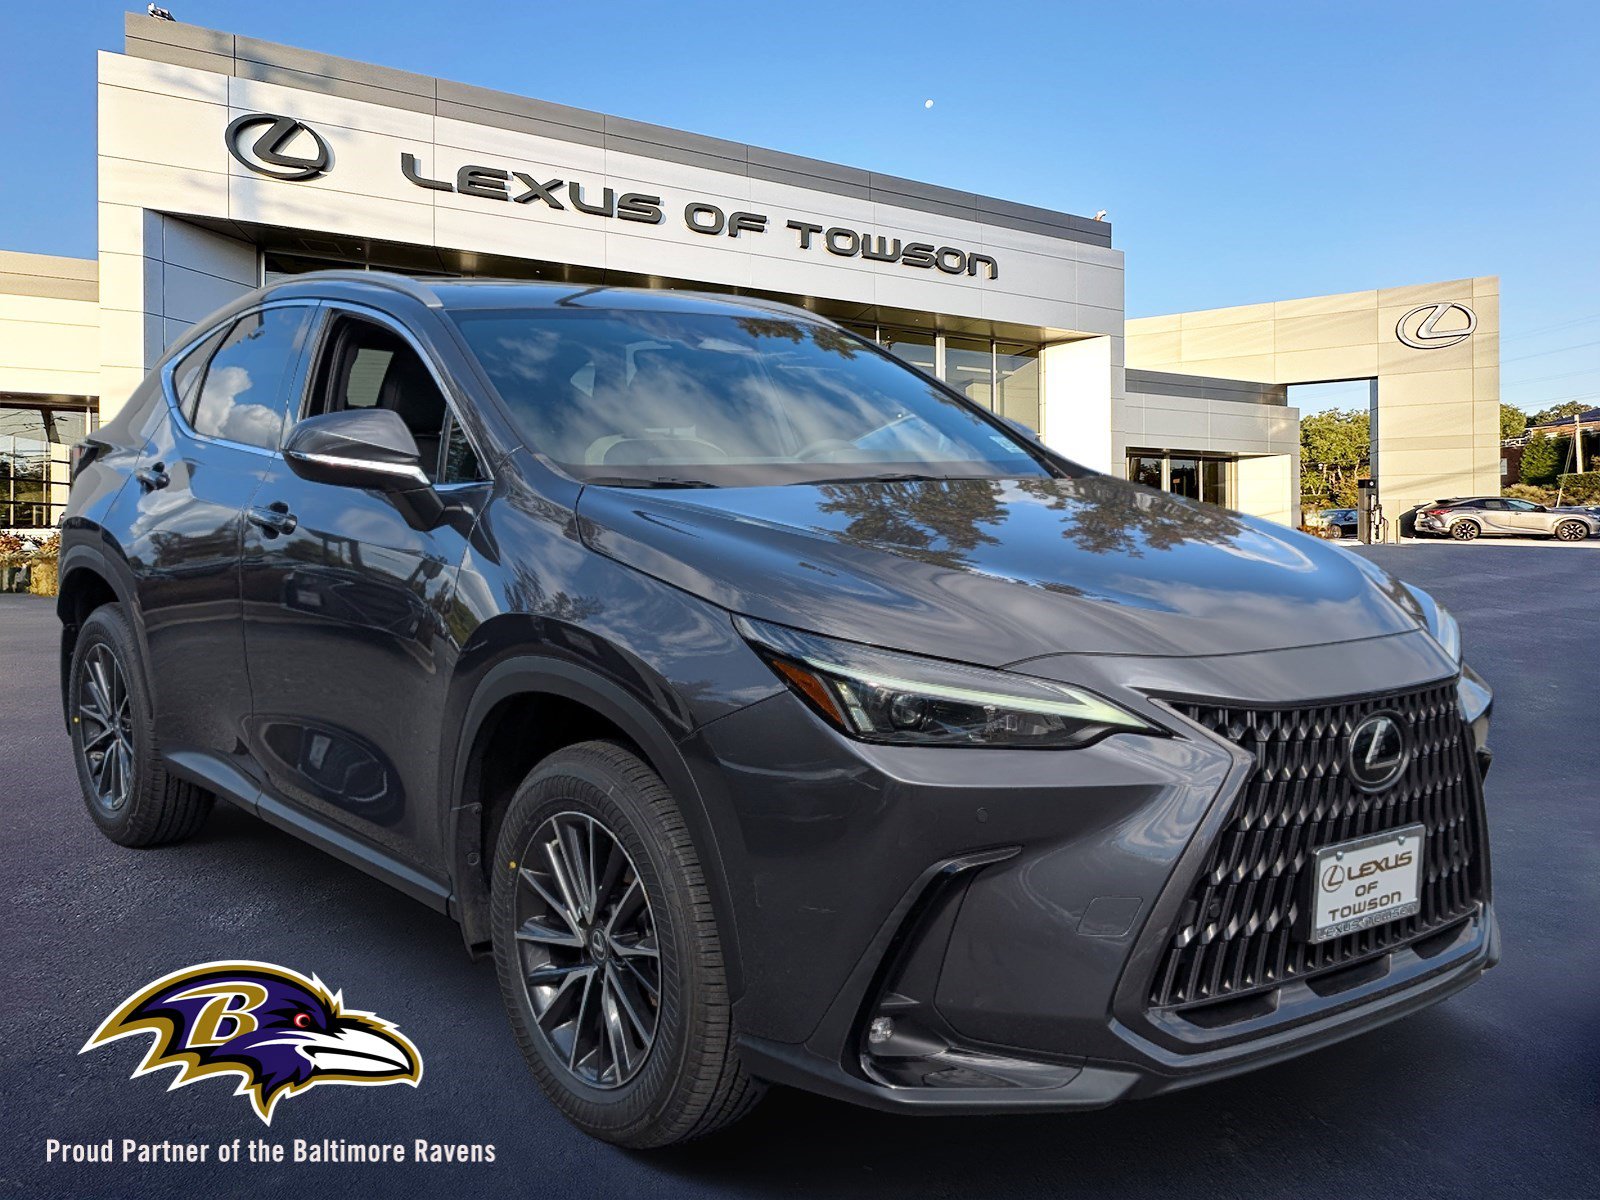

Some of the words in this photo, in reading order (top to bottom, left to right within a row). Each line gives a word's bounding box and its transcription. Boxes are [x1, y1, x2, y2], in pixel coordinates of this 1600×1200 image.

[401, 152, 662, 225] LEXUS
[684, 202, 767, 237] OF
[787, 219, 998, 280] TOWSON
[1346, 851, 1413, 880] LEXUS
[1355, 881, 1378, 897] OF
[1328, 891, 1402, 921] TOWSON
